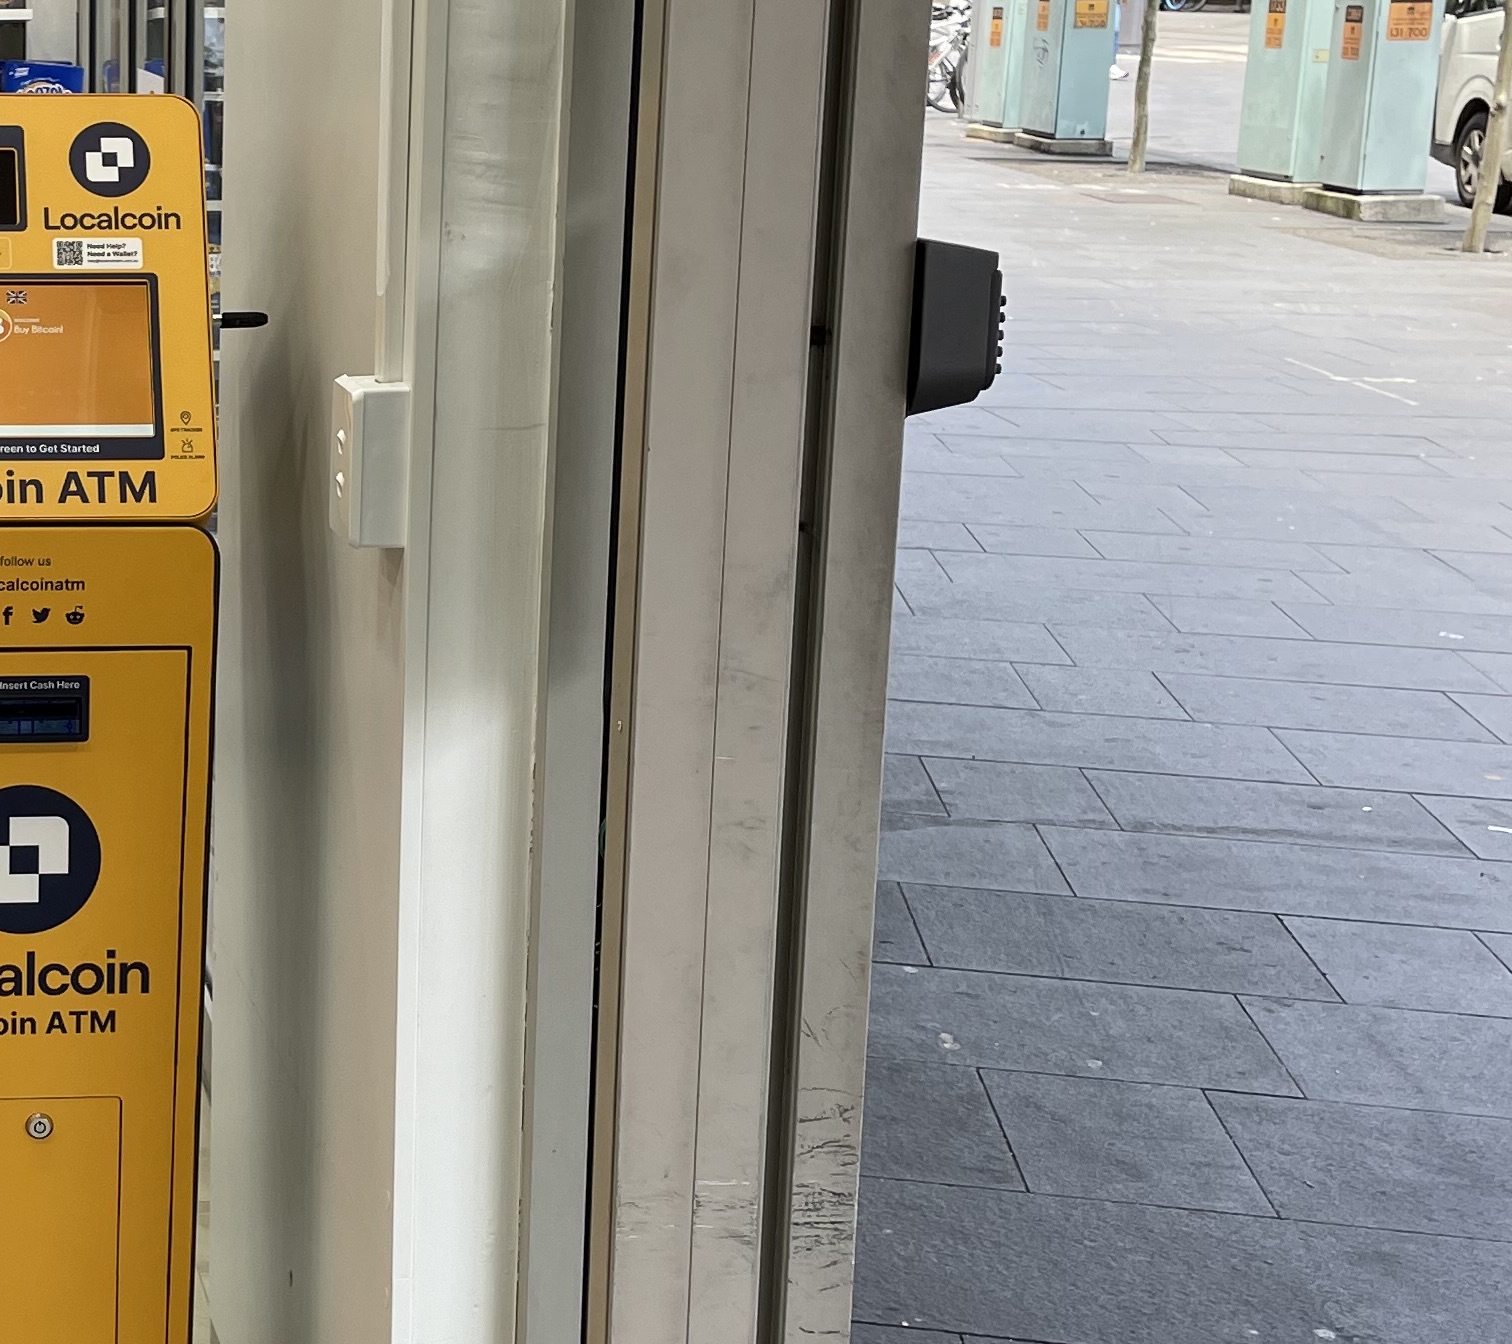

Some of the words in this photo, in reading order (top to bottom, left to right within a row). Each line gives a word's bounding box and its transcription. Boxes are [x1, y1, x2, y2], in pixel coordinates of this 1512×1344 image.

[1408, 27, 1428, 37] 700
[44, 206, 181, 230] Localcoin
[13, 324, 30, 335] Buy
[26, 444, 37, 454] to
[38, 443, 59, 454] Get
[60, 443, 100, 454] Started
[58, 470, 158, 504] ATM
[0, 555, 35, 567] follow
[38, 557, 51, 567] us
[0, 681, 28, 690] Insert
[30, 681, 55, 690] Cash
[57, 681, 81, 690] Here
[45, 1010, 117, 1035] ATM
